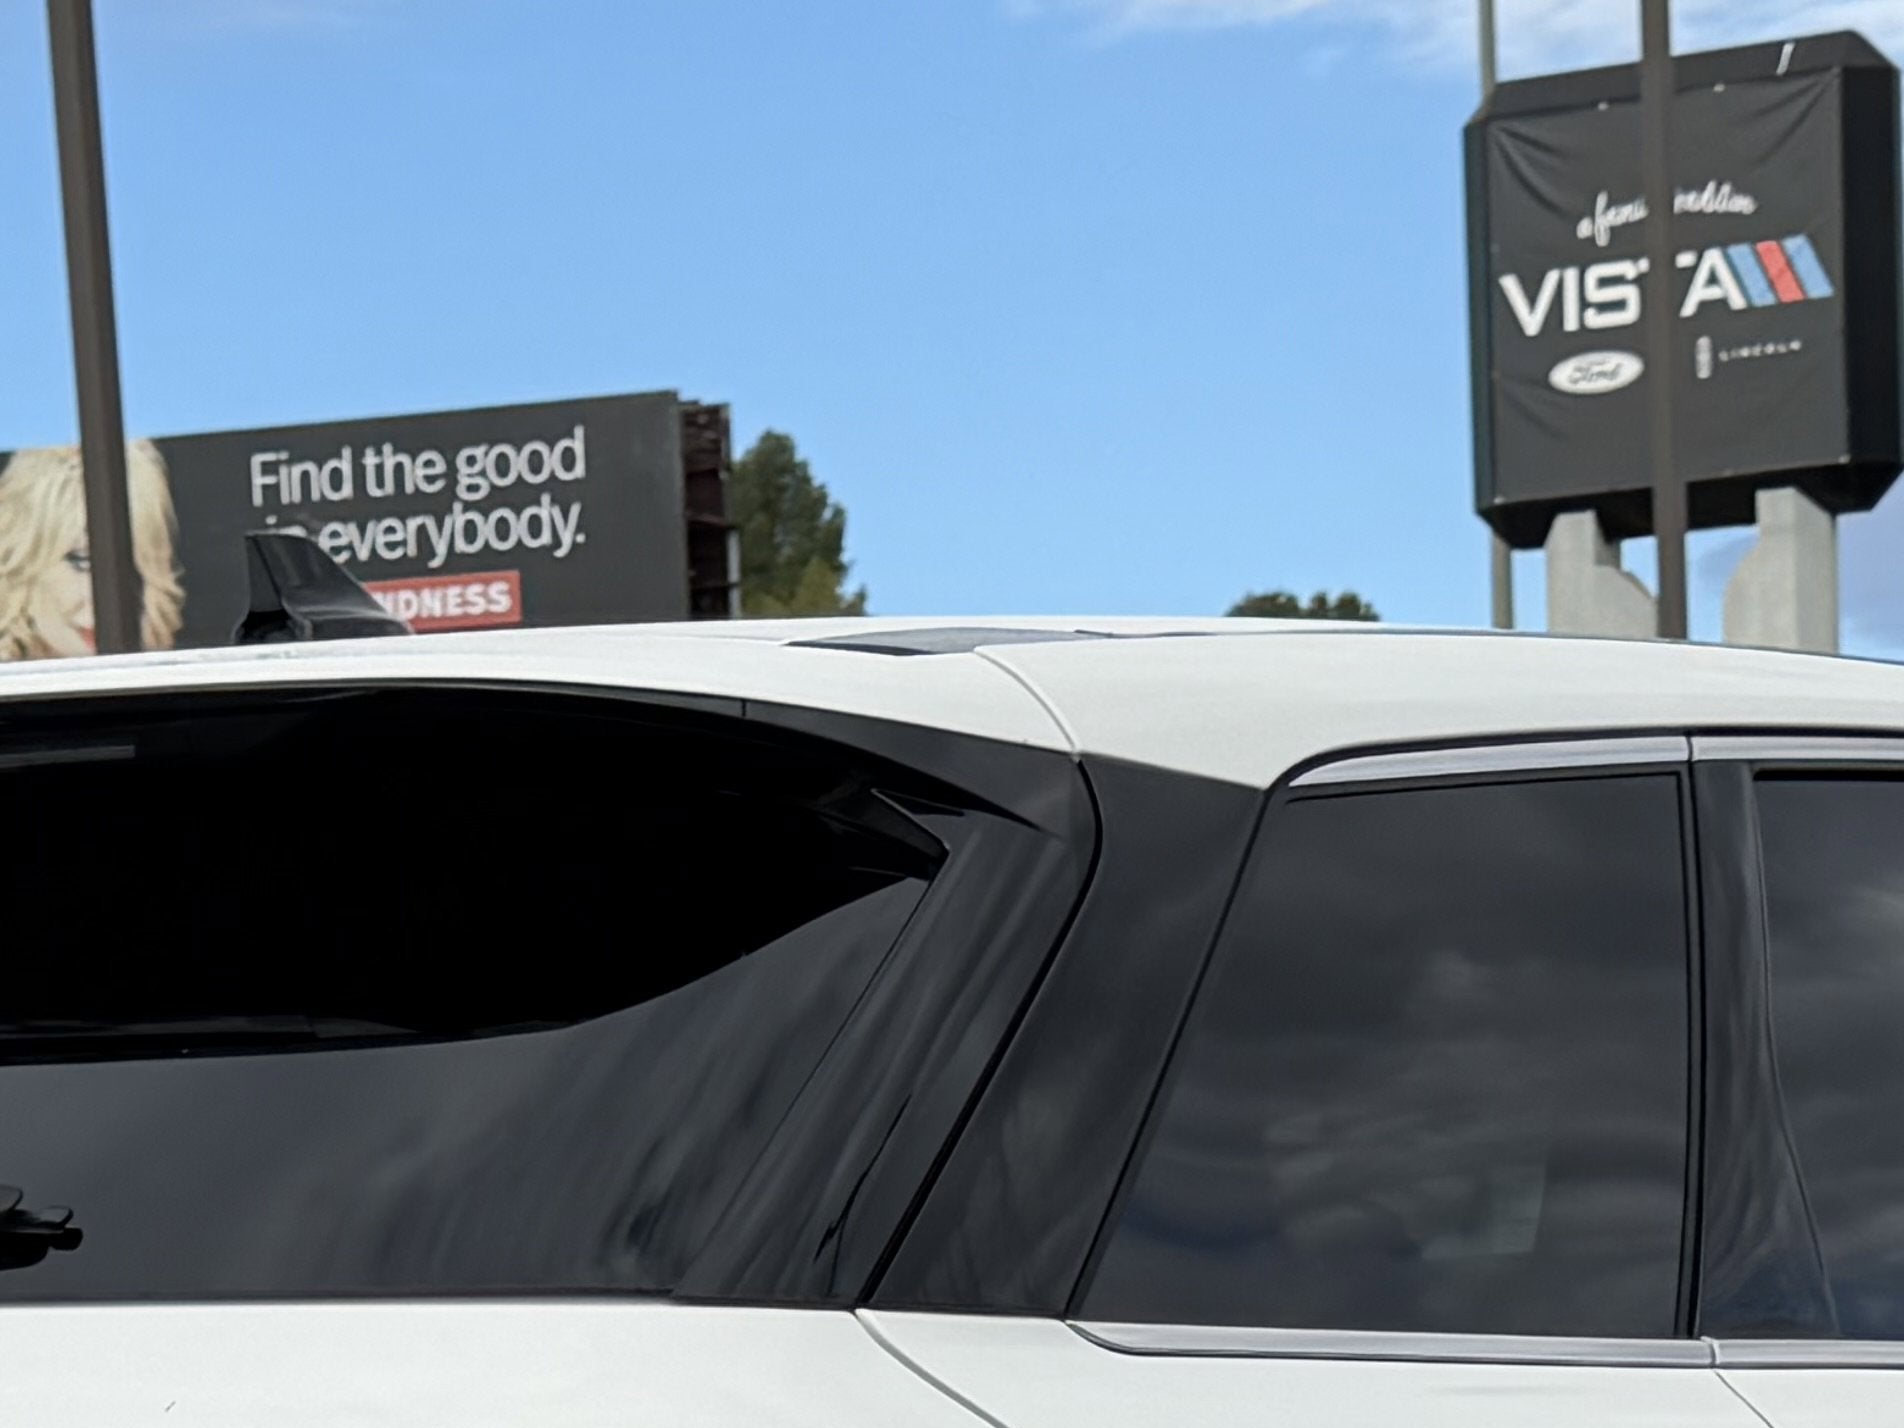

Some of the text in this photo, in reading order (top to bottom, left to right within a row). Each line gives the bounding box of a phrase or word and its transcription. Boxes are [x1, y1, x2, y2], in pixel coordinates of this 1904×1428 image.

[250, 424, 586, 507] Find the good
[318, 492, 587, 568] everybody.
